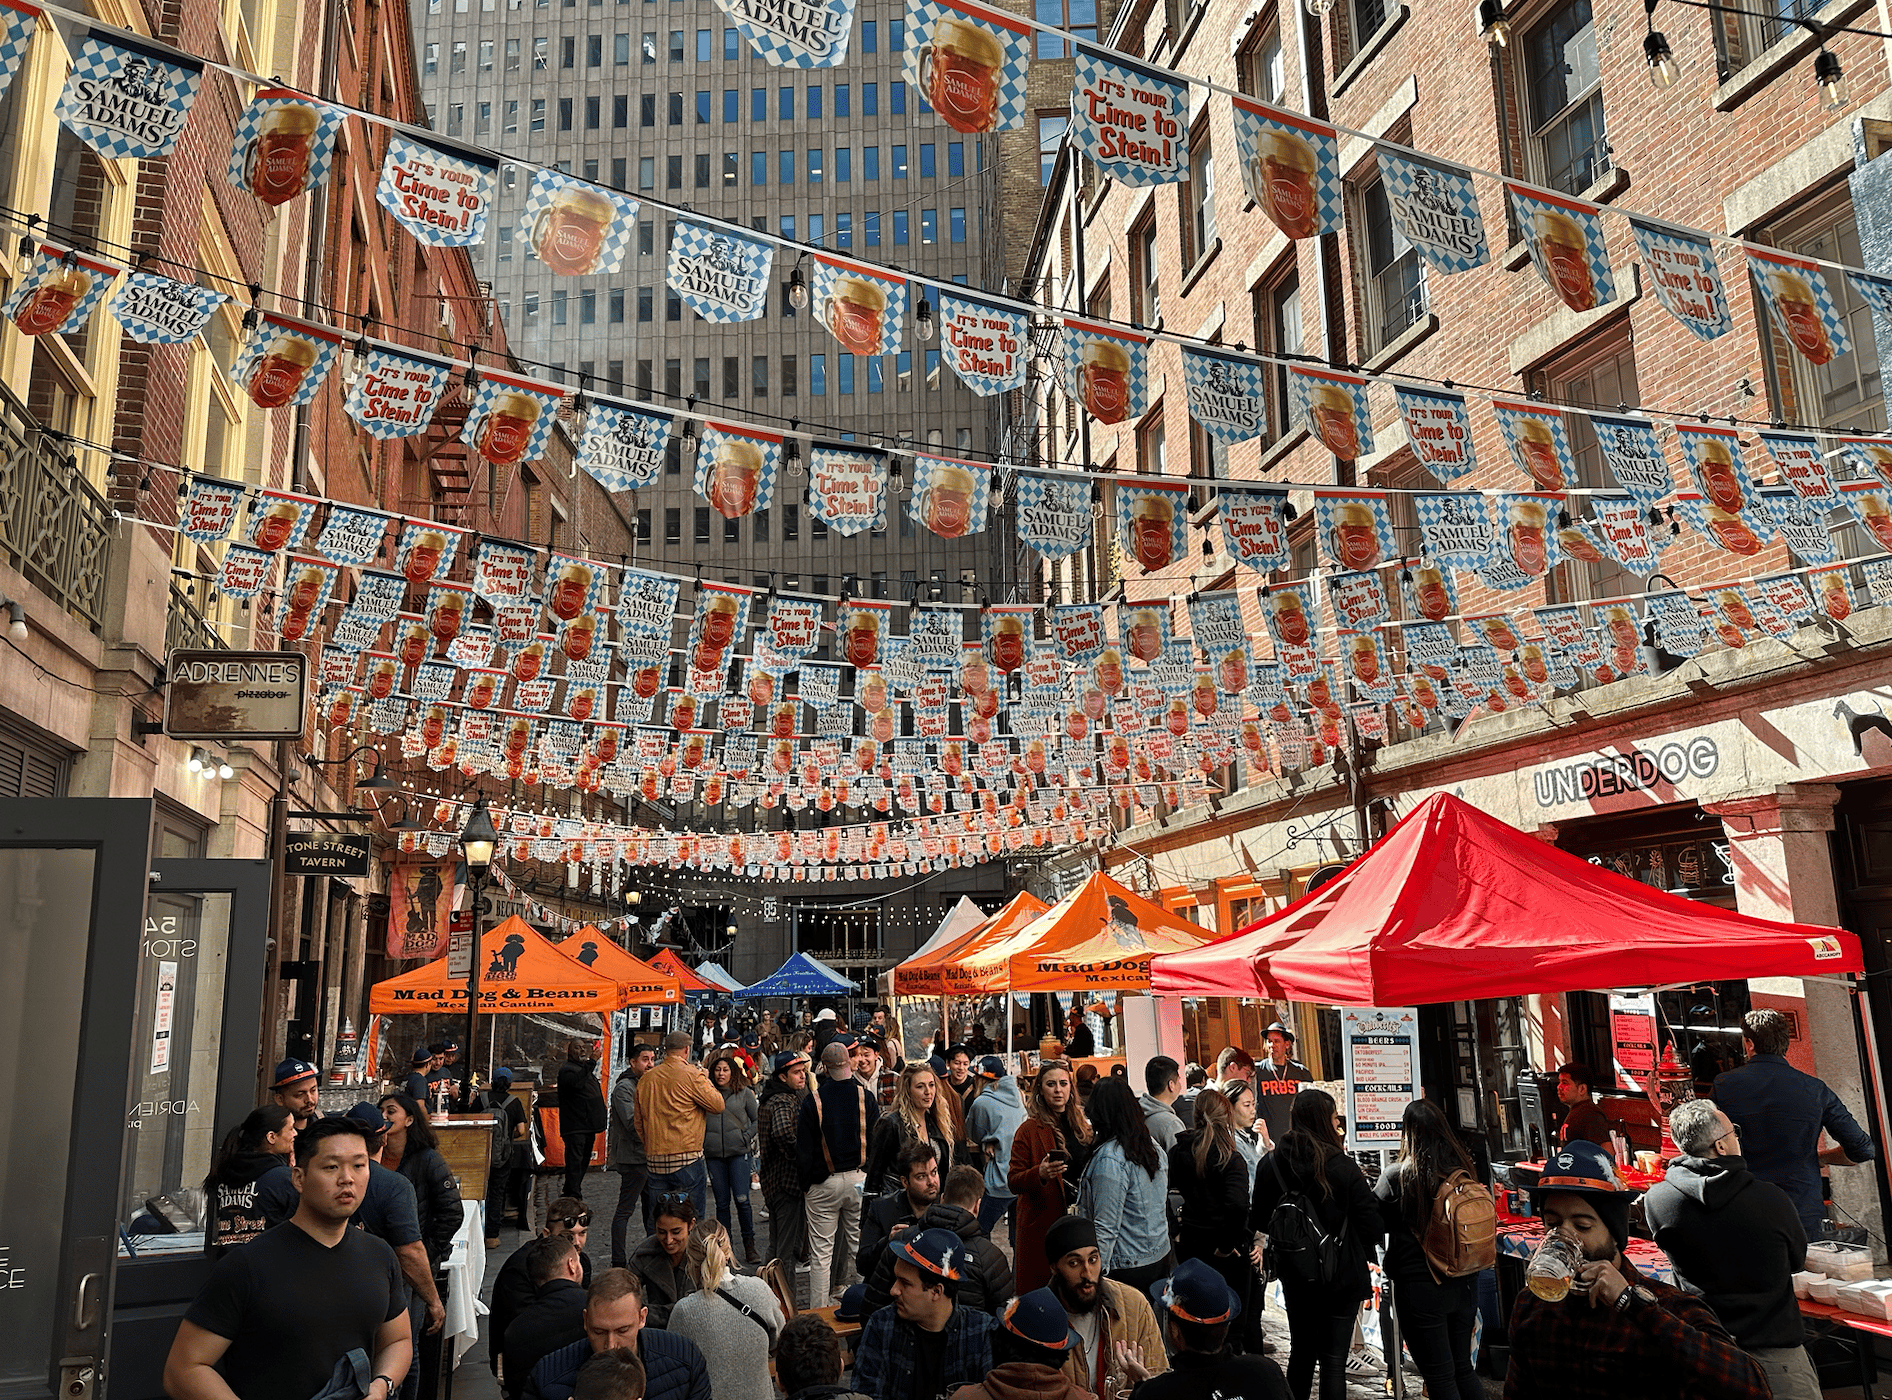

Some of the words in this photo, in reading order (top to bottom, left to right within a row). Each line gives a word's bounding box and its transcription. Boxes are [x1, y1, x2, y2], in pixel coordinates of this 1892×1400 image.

[733, 0, 827, 51] ADAMS
[764, 0, 841, 35] MUEL
[943, 75, 982, 94] SAMUEL
[946, 83, 980, 104] ADAMS
[1099, 79, 1125, 97] IT'S
[1132, 89, 1166, 108] YOUR
[75, 79, 178, 129] SAMUEL
[1084, 89, 1146, 131] Time
[1153, 110, 1176, 137] to
[77, 102, 161, 145] ADAMS
[1098, 127, 1171, 167] Stein!
[407, 159, 434, 175] IT'S
[438, 168, 473, 187] YOUR
[393, 165, 449, 203] Time
[457, 181, 479, 210] to
[402, 195, 469, 232] Stein!
[1395, 197, 1477, 237] SAMUEL
[1405, 220, 1472, 254] ADAMS
[1652, 248, 1671, 263] IT'S
[1674, 252, 1699, 267] YOUR
[678, 258, 759, 294] SAMUEL
[1647, 258, 1690, 291] Time
[1693, 271, 1712, 292] to
[680, 276, 751, 309] ADAMS
[126, 287, 199, 325] SAMUEL
[1668, 288, 1715, 320] Stein!
[122, 302, 189, 334] ADAMS
[957, 315, 976, 327] IT'S
[982, 319, 1009, 332] YOUR
[947, 322, 992, 350] Time
[998, 333, 1017, 353] to
[959, 349, 1012, 376] Stein!
[379, 367, 399, 378] IT'S
[404, 370, 430, 383] YOUR
[365, 374, 409, 400] Time
[414, 385, 431, 402] to
[1192, 387, 1257, 412] SAMUEL
[364, 398, 422, 424] Stein!
[1200, 404, 1254, 427] ADAMS
[1410, 408, 1426, 419] IT'S
[1430, 409, 1453, 420] YOUR
[1405, 418, 1444, 441] Time
[1447, 425, 1463, 440] to
[588, 436, 657, 464] SAMUEL
[1421, 443, 1463, 463] Stein!
[590, 454, 649, 477] ADAMS
[827, 463, 843, 472] IT'S
[848, 464, 871, 473] YOUR
[1609, 454, 1660, 474] SAMUEL
[1775, 460, 1808, 478] Time
[1810, 461, 1824, 476] to
[816, 473, 857, 494] Time
[863, 477, 878, 492] to
[1618, 470, 1662, 487] ADAMS
[1795, 480, 1829, 498] Stein!
[190, 501, 219, 516] Time
[221, 504, 231, 516] to
[826, 495, 874, 517] Stein!
[1232, 506, 1246, 516] IT'S
[1250, 506, 1271, 515] YOUR
[189, 516, 225, 532] Stein!
[1024, 508, 1085, 528] SAMUEL
[1224, 517, 1262, 536] Time
[1266, 518, 1278, 534] to
[325, 531, 373, 547] SAMUEL
[1028, 524, 1080, 542] ADAMS
[1427, 525, 1489, 541] SAMUEL
[325, 539, 372, 557] ADAMS
[1241, 537, 1278, 558] Stein!
[1438, 540, 1487, 553] ADAMS
[490, 555, 503, 563] IT'S
[506, 555, 524, 564] YOUR
[482, 562, 513, 578] Time
[516, 567, 528, 580] to
[485, 578, 522, 595] Stein!
[622, 598, 668, 614] SAMUEL
[623, 609, 664, 625] ADAMS
[771, 617, 801, 632] Time
[804, 619, 815, 631] to
[776, 633, 811, 648] Stein!
[913, 634, 958, 646] SAMUEL
[917, 645, 955, 656] ADAMS
[175, 663, 298, 682] ADRIENNE'S
[236, 689, 289, 700] pizzabar
[1534, 736, 1718, 807] UNDERDOG
[287, 842, 319, 854] TONE
[323, 841, 366, 859] STREET
[300, 857, 346, 868] TAVERN
[946, 969, 958, 979] Mad
[959, 968, 972, 981] Dog
[973, 970, 978, 978] &
[980, 965, 1002, 977] Beans
[1036, 962, 1094, 973] Mad
[1100, 961, 1150, 974] Dog
[393, 990, 443, 999] Mad
[502, 989, 522, 999] &
[527, 988, 598, 999] Beans
[629, 984, 664, 993] ans
